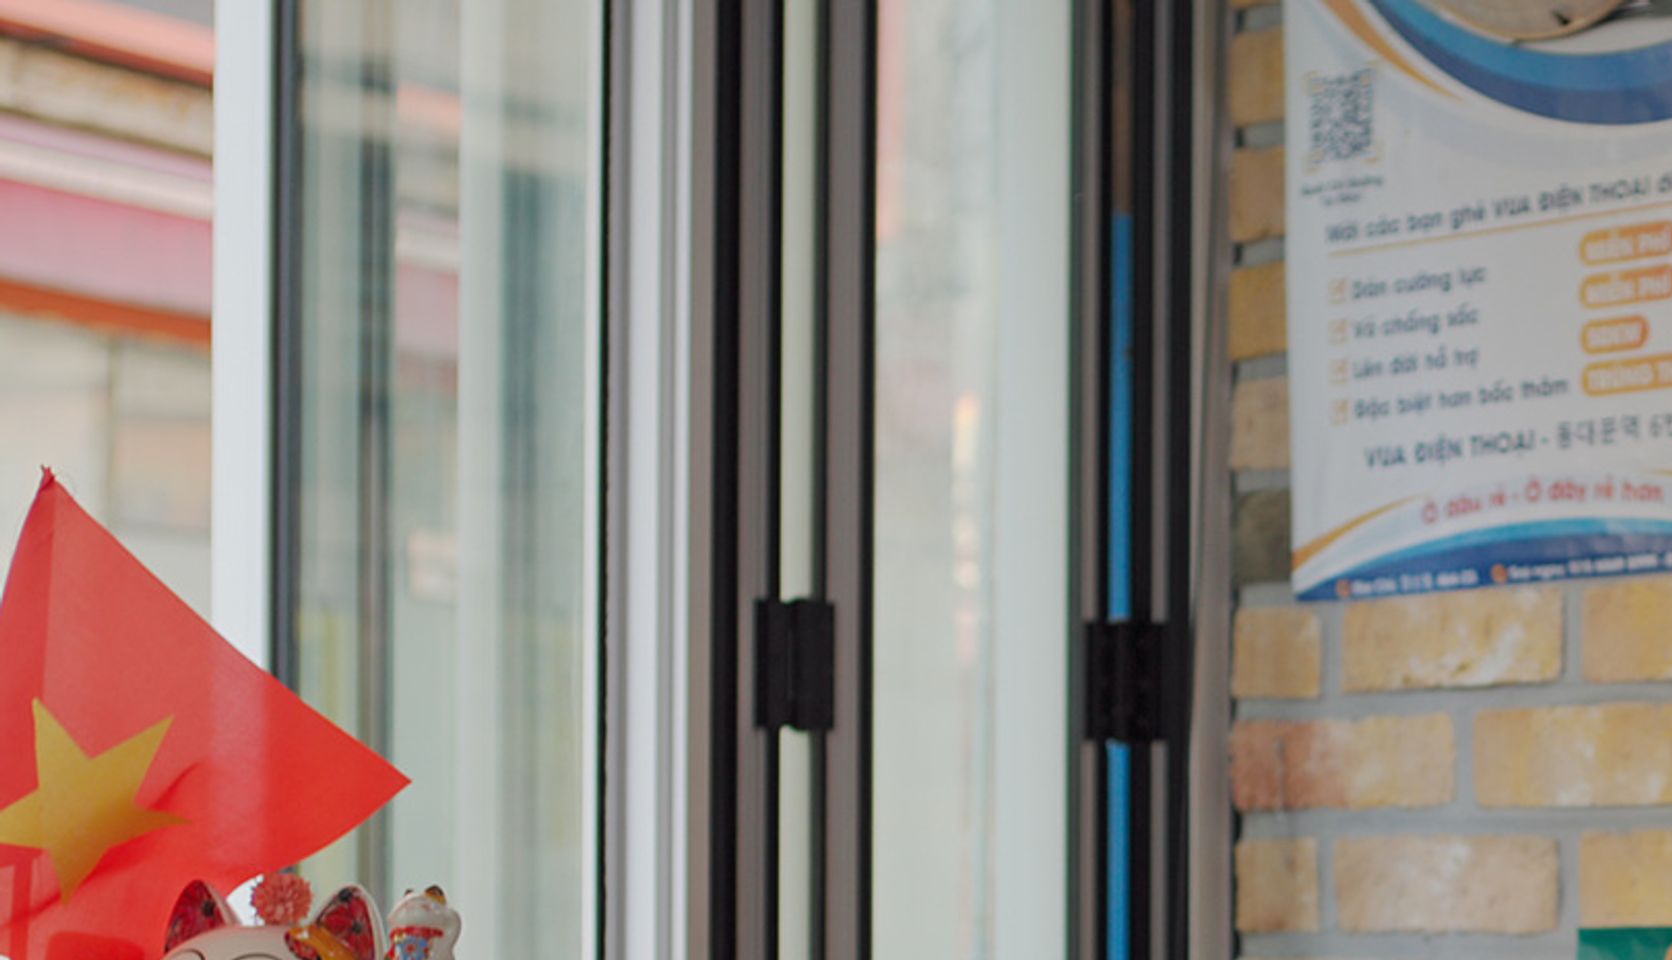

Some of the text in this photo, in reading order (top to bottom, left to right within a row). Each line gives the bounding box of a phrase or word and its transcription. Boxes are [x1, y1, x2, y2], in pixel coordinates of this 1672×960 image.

[1494, 196, 1531, 217] VUA
[1539, 182, 1582, 212] ĐIỆN
[1589, 177, 1649, 203] THOẠI
[1365, 446, 1407, 469] VUA
[1415, 434, 1463, 466] ĐIỆN
[1470, 429, 1535, 458] THOẠI
